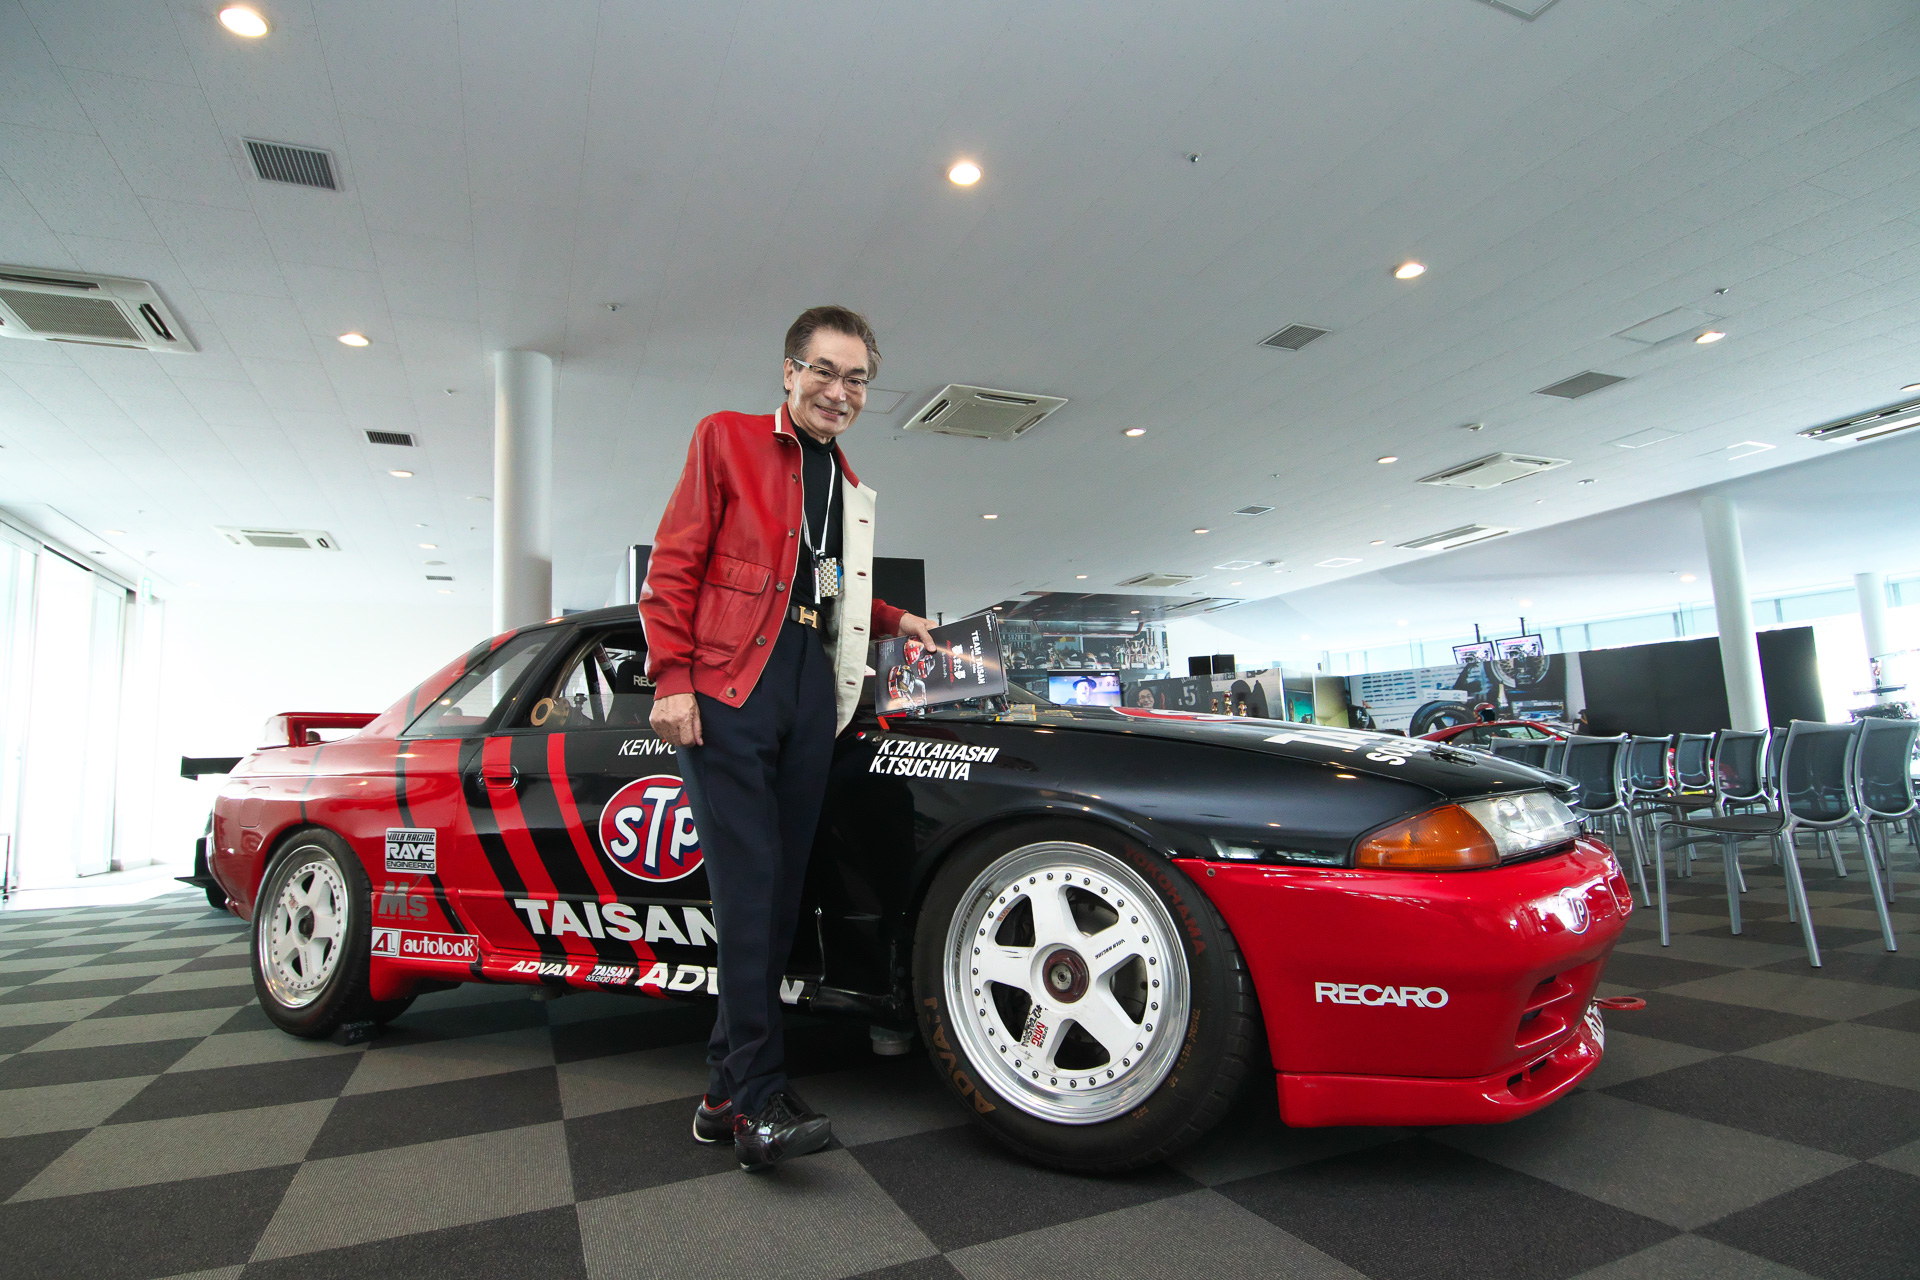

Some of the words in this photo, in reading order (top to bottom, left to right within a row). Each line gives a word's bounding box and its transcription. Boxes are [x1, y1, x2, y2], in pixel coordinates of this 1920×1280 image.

[971, 630, 982, 656] TEAM
[976, 657, 986, 685] TAISAN
[877, 739, 1000, 763] K.TAKAHASHI
[868, 755, 971, 781] K.TSUCHIYA
[387, 833, 406, 841] VOLK
[406, 833, 435, 842] RACING
[610, 785, 700, 873] STP
[386, 842, 435, 860] RAYS
[386, 860, 435, 869] ENGINEERING
[1123, 842, 1206, 956] YOKOHAMA
[403, 936, 474, 957] autolook
[508, 960, 580, 977] ADVAN
[585, 974, 611, 983] SOLENOID
[591, 965, 634, 979] TAISAN
[1314, 981, 1449, 1009] RECARO
[1031, 1021, 1046, 1047] MAG
